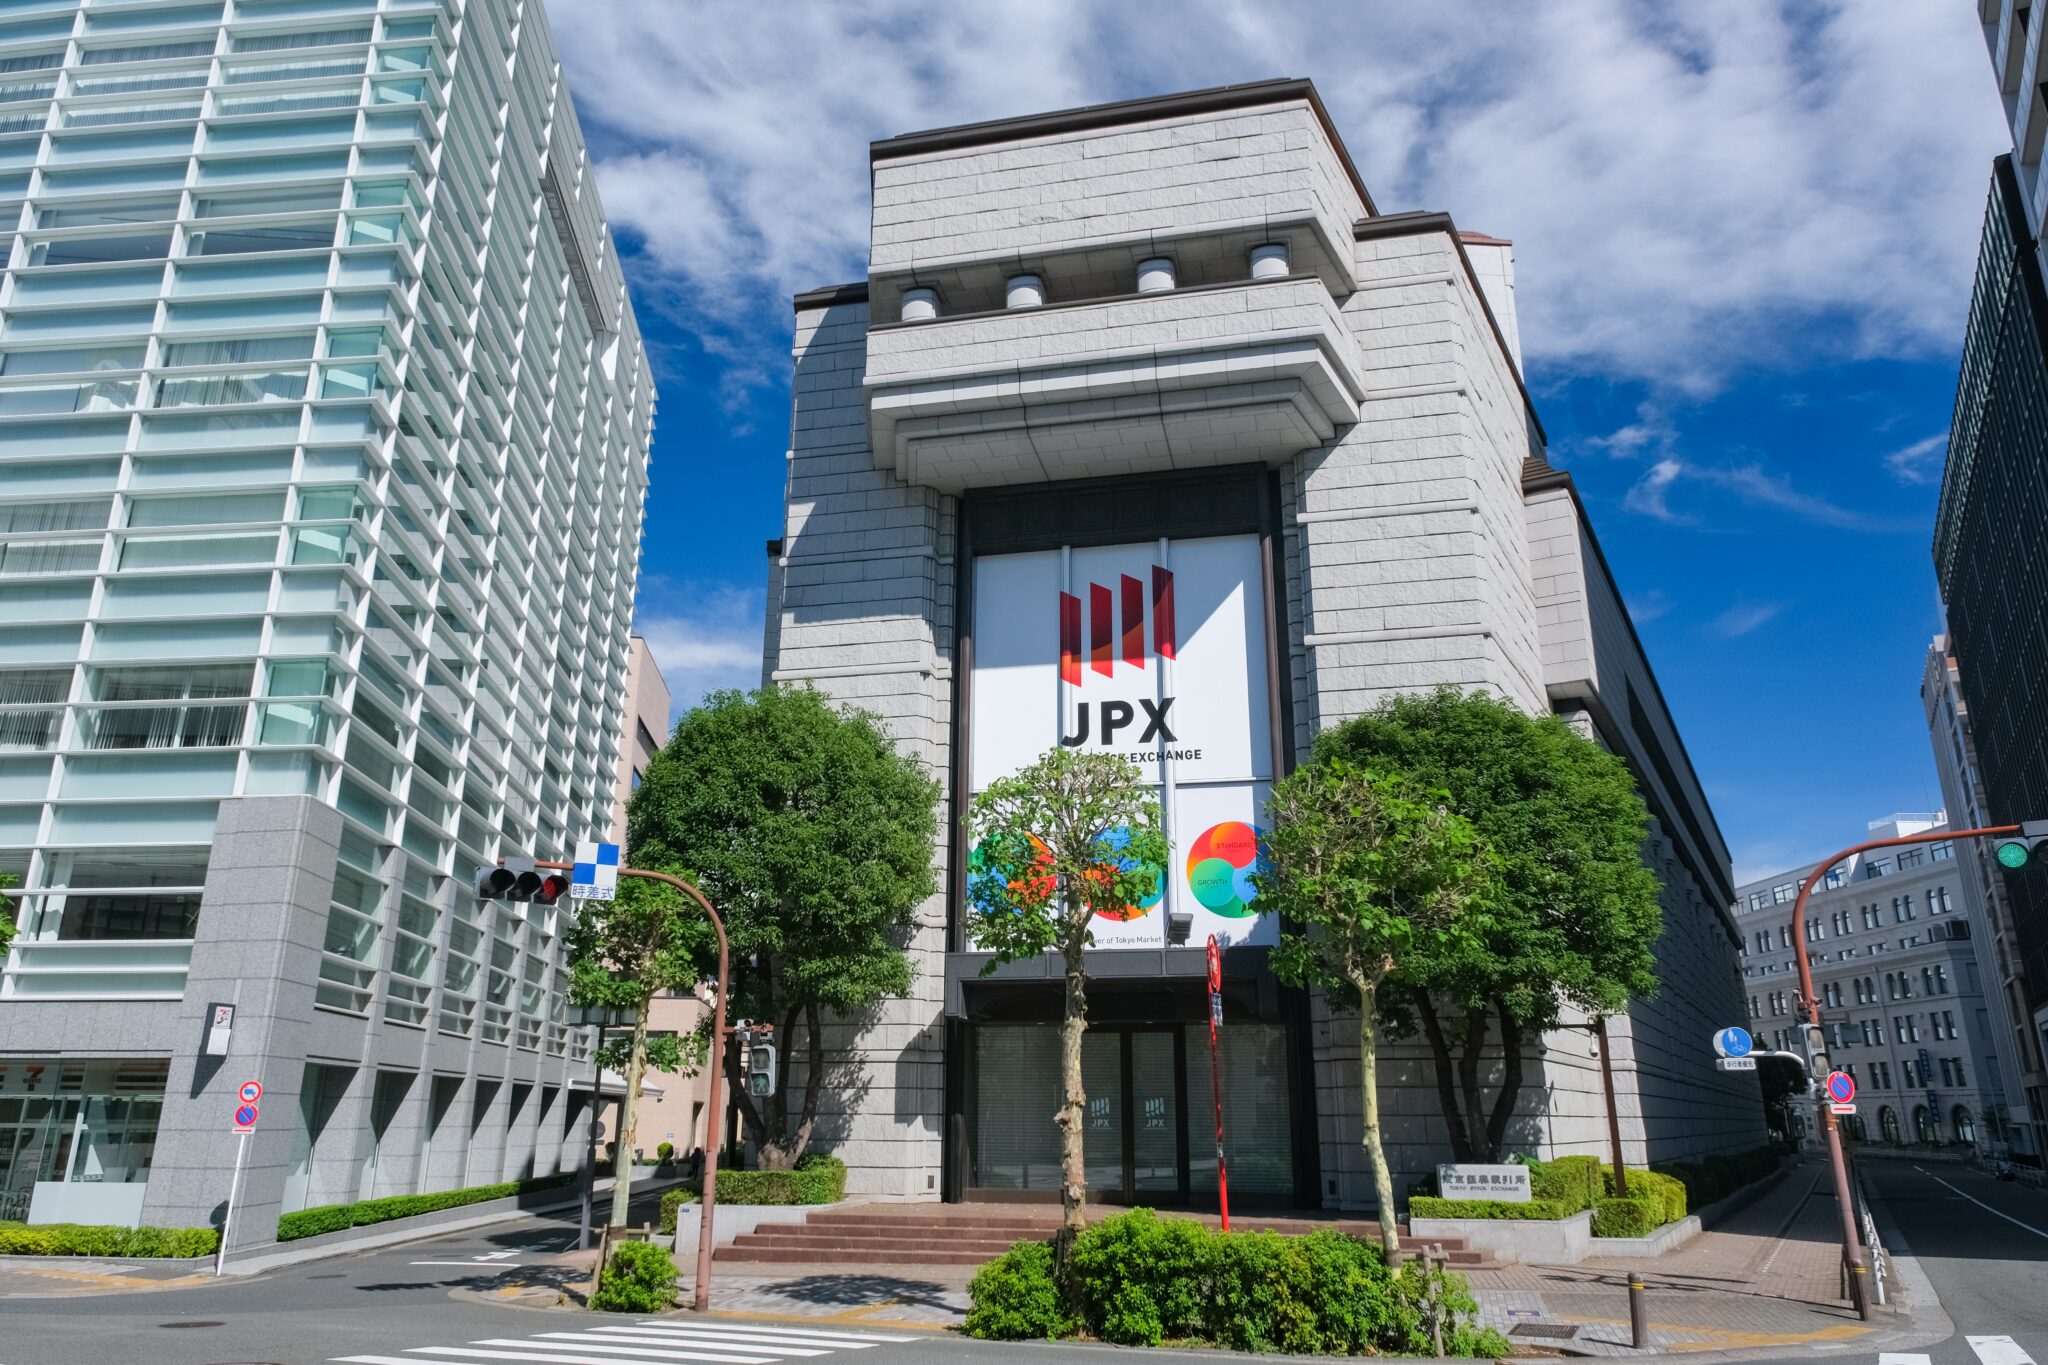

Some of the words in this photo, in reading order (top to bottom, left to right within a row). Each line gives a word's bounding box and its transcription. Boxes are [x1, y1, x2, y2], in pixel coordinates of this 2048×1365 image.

[1061, 697, 1178, 747] JPX
[1130, 750, 1202, 763] EXCHANGE
[573, 886, 613, 899] 時差式
[1115, 937, 1135, 945] Tokyo
[1136, 936, 1162, 944] Market
[1092, 1119, 1109, 1127] JPX
[1146, 1119, 1164, 1127] JPX
